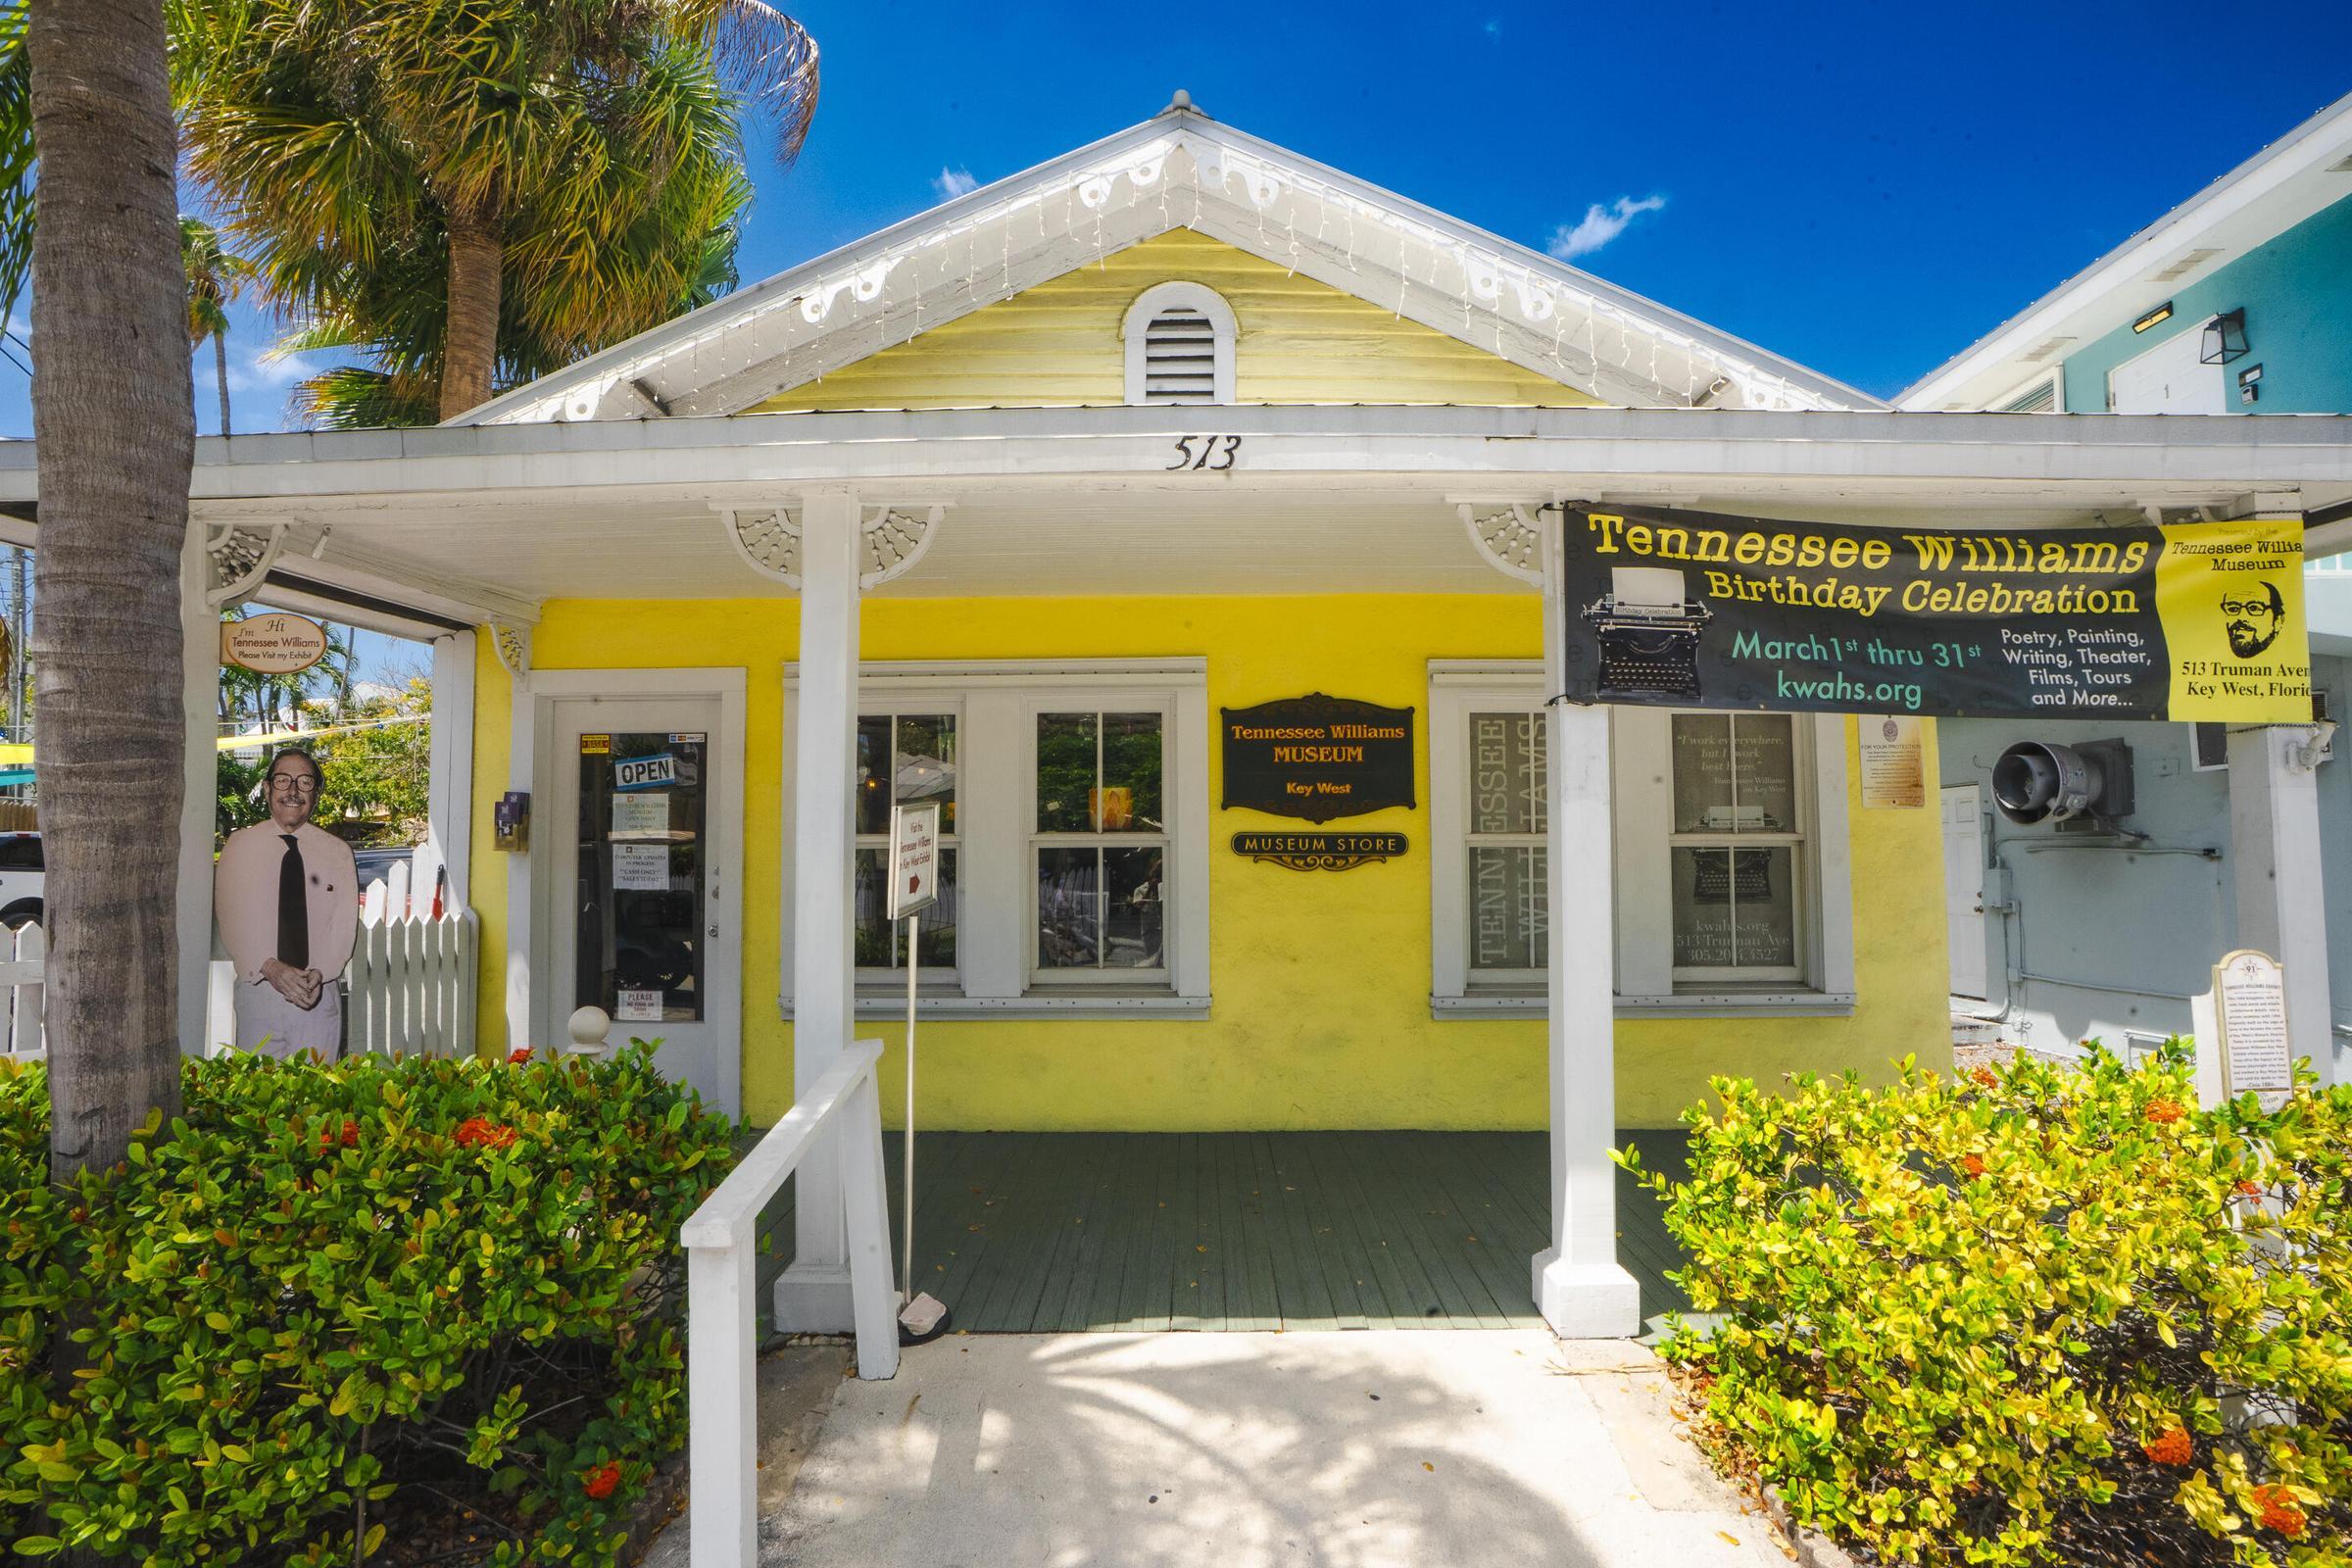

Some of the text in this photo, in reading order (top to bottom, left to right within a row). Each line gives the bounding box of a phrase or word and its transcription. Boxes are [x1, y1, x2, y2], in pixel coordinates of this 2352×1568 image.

[1165, 435, 1242, 470] 513
[1588, 513, 2149, 574] Tennessee Williams
[2172, 540, 2304, 555] Tennessee Willia
[2211, 558, 2286, 571] Museum
[1704, 570, 2139, 616] Birthday Celebration
[239, 627, 254, 637] I'm
[265, 617, 286, 632] Hi
[232, 637, 320, 648] Tennessee Williams
[2001, 628, 2145, 648] Poetry, Painting,
[238, 651, 261, 660] Please
[262, 651, 275, 660] Visit
[289, 651, 313, 660] Exhibit
[1867, 638, 1924, 666] thru
[1935, 643, 1982, 668] 31st
[2001, 650, 2152, 668] Writing, Theater,
[2181, 662, 2206, 676] 513
[2210, 662, 2272, 676] Truman
[2029, 669, 2132, 687] Films, Tours
[1777, 669, 1922, 710] kwahs.org
[2186, 681, 2217, 699] Key
[2222, 681, 2264, 698] West,
[2032, 690, 2133, 707] and More...
[1231, 724, 1405, 740] Tennessee Williams
[1690, 735, 1716, 745] work
[1273, 746, 1365, 762] MUSEUM
[621, 759, 670, 784] OPEN
[1286, 782, 1352, 797] Key West
[1245, 838, 1396, 852] MUSEUM STORE
[1677, 934, 1700, 947] 513
